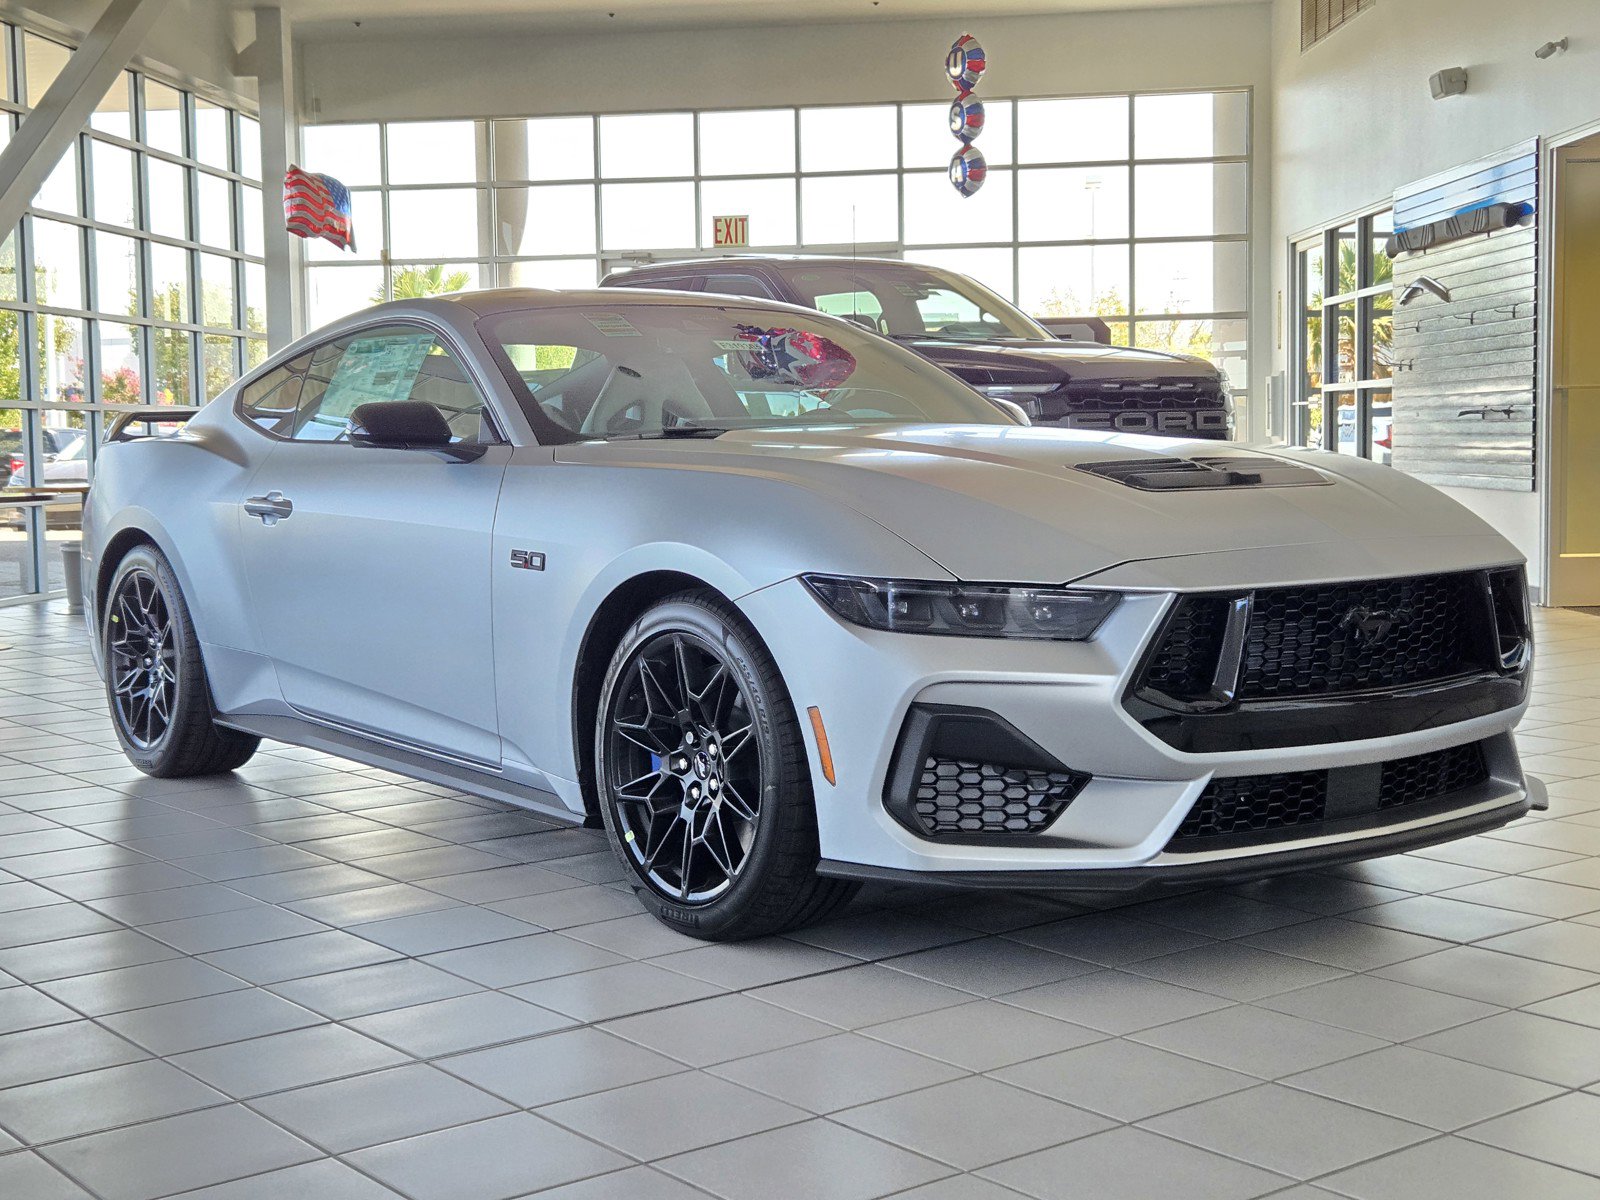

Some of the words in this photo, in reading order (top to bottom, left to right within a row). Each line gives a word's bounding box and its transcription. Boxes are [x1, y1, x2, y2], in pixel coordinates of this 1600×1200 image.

[714, 217, 748, 245] EXIT
[1069, 411, 1228, 432] FORD
[736, 656, 762, 704] 255/40
